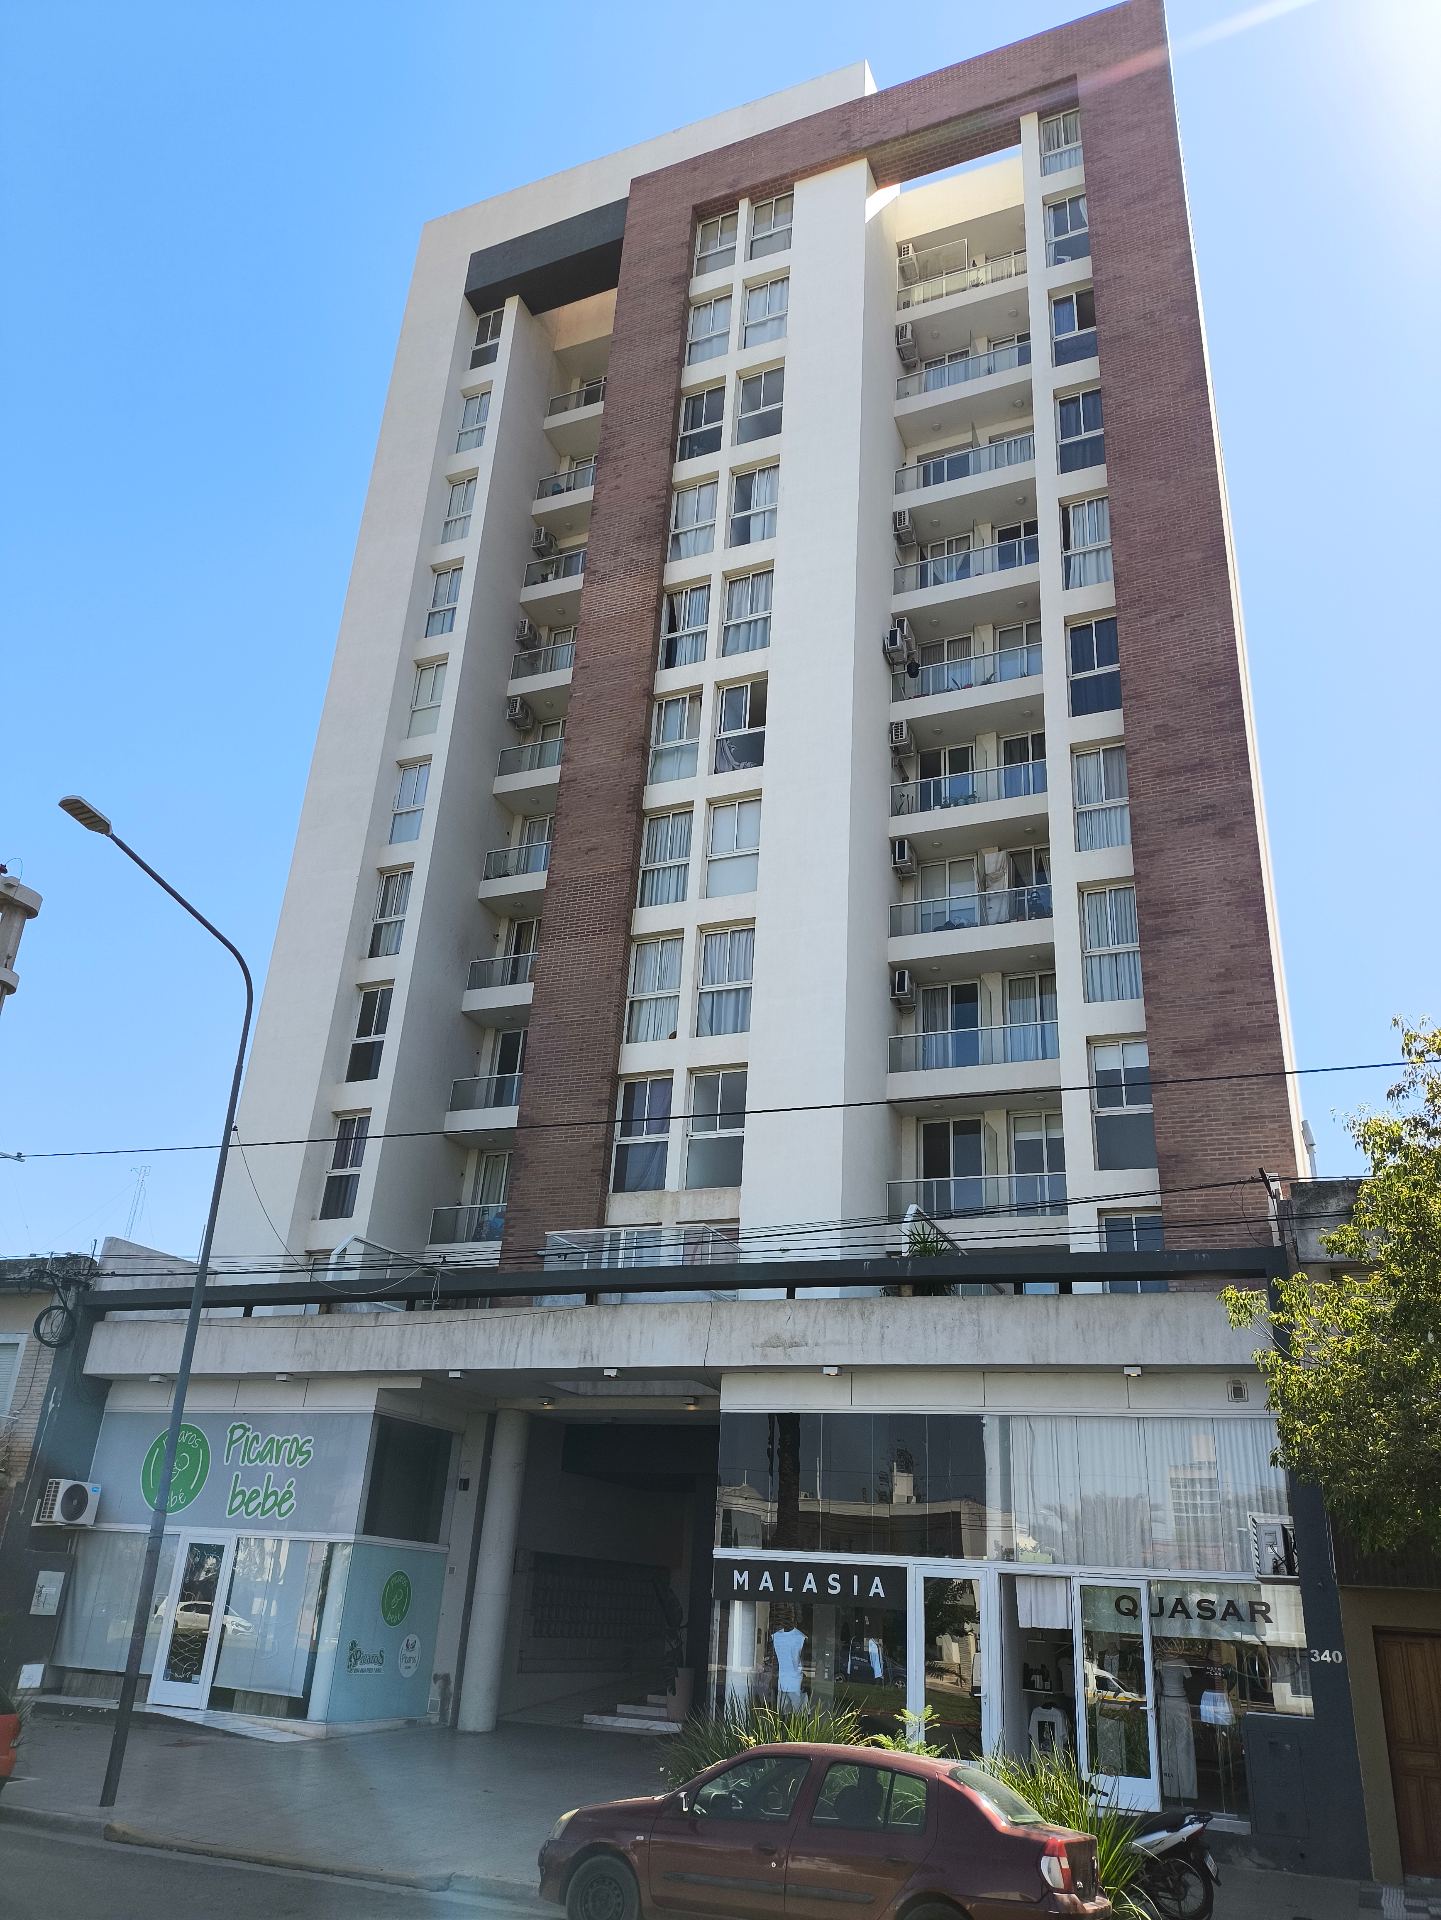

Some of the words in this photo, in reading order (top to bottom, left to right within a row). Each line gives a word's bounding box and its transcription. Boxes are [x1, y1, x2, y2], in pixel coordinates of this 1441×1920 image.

[226, 1472, 296, 1520] bebé
[733, 1569, 885, 1598] MALASIA
[1114, 1594, 1273, 1623] QUASAR
[1310, 1649, 1343, 1664] 340
